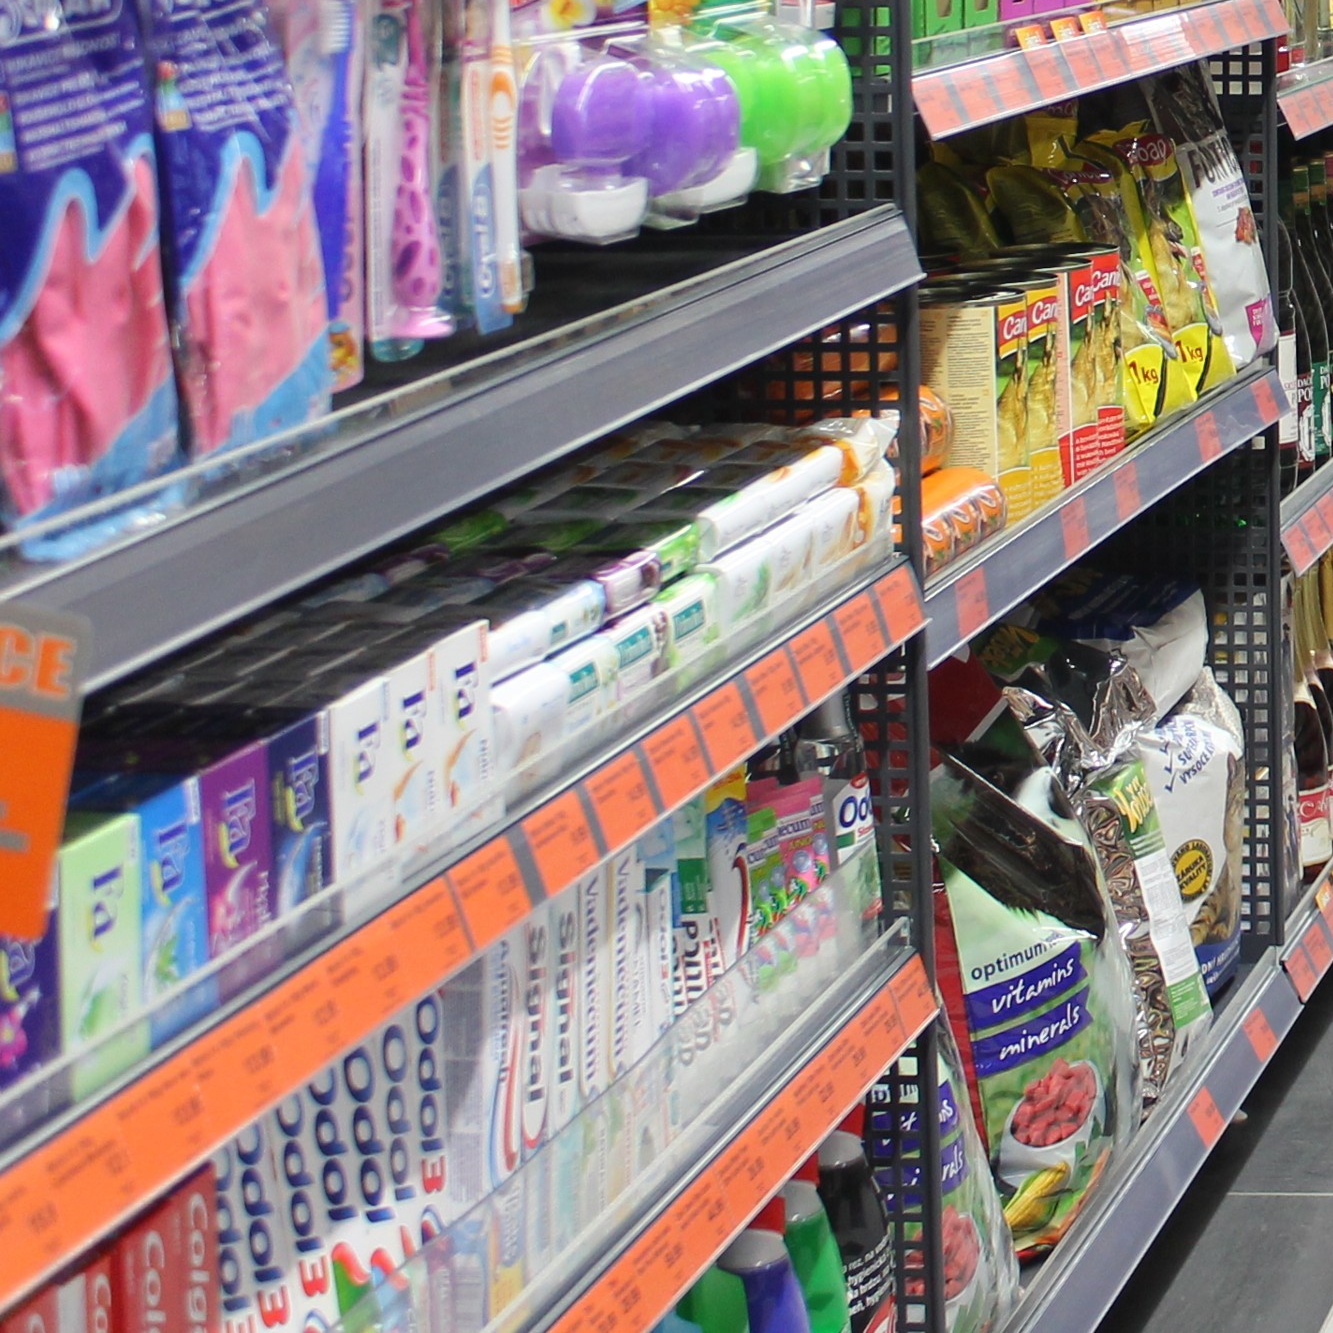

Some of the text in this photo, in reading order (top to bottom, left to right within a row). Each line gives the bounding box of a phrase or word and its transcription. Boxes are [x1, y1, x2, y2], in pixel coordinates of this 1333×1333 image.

[1127, 360, 1160, 385] 1 kg
[1174, 339, 1204, 364] 1 kg
[0, 623, 74, 699] CE
[453, 659, 477, 721] Fa
[354, 721, 381, 784] Fa
[401, 689, 428, 750] Fa
[222, 776, 257, 859] Fa
[287, 749, 320, 823] Fa
[156, 818, 192, 894] Fa
[90, 865, 125, 943] Fa
[526, 925, 548, 1103] Signal
[557, 909, 577, 1085] Signal
[992, 957, 1075, 1014] vitamins
[1000, 1002, 1081, 1061] minerals
[343, 1046, 396, 1223] Odol
